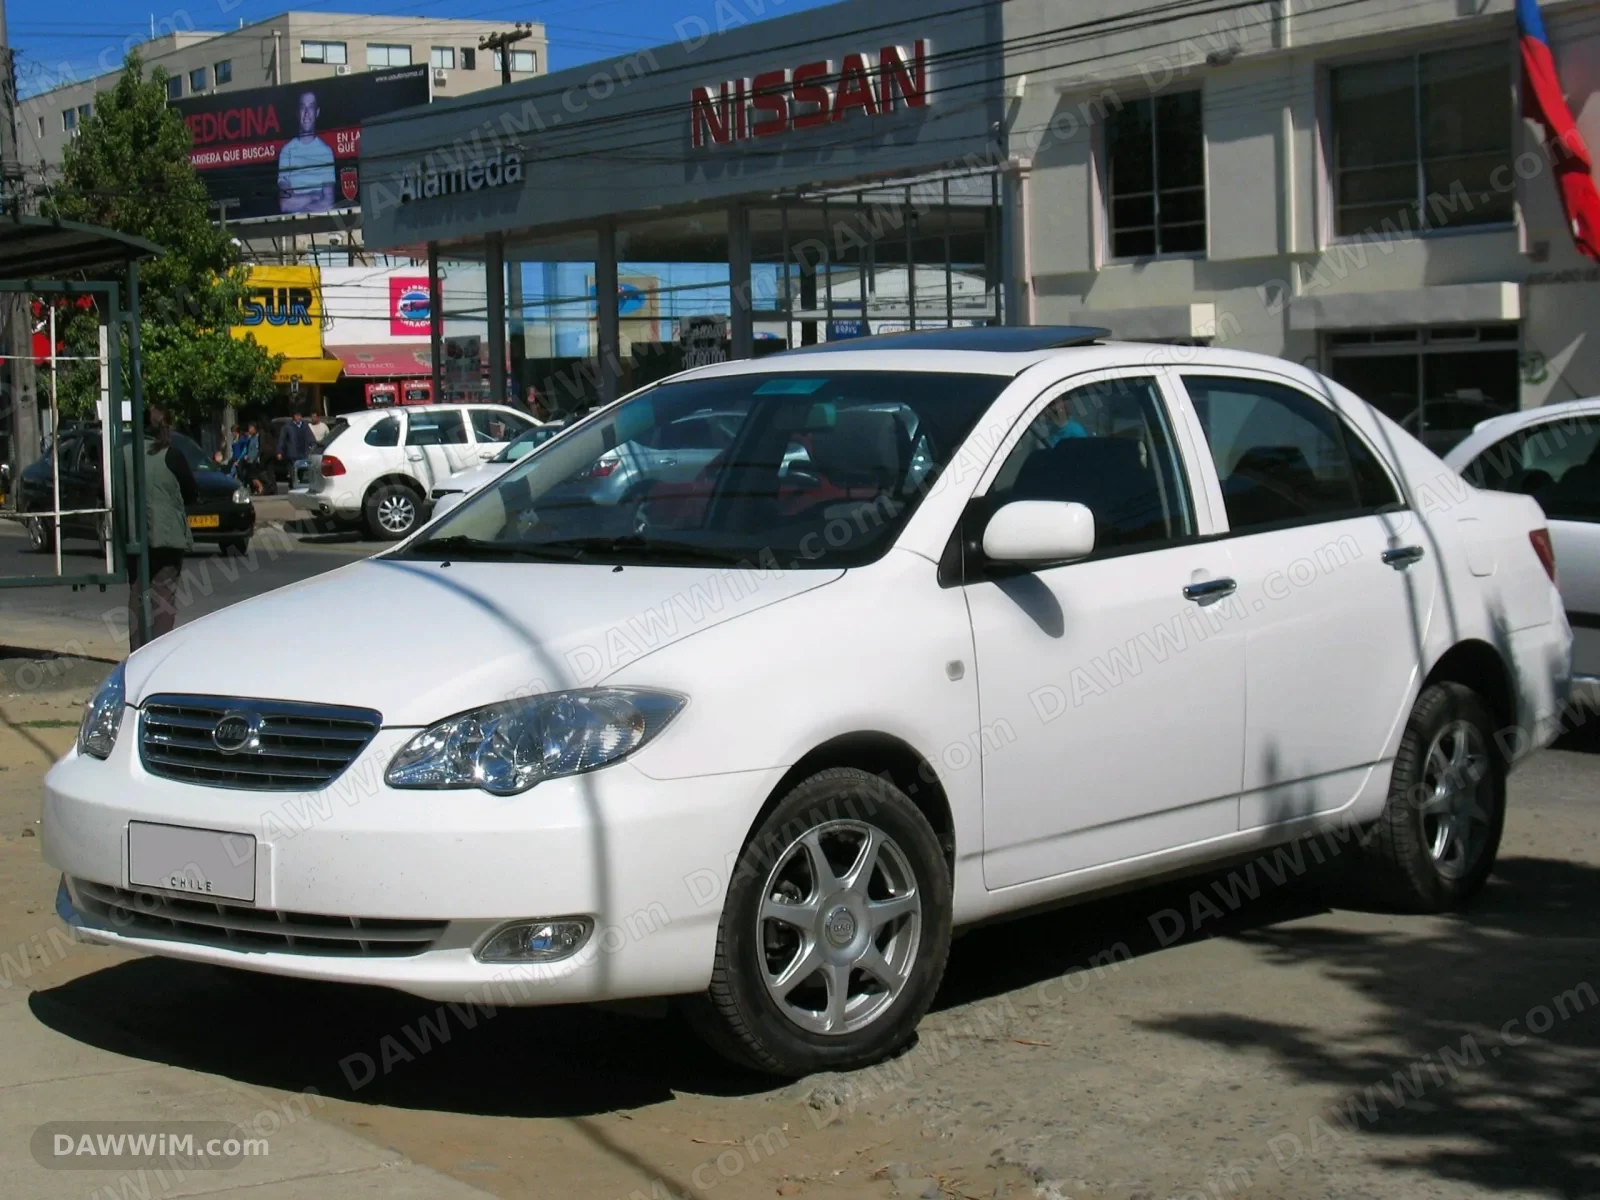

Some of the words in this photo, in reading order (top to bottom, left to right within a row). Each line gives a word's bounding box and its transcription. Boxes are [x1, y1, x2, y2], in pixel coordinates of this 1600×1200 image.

[691, 39, 931, 148] NISSAN
[185, 105, 281, 144] EDICINA
[337, 132, 349, 143] EN
[188, 152, 222, 164] ARRERA
[223, 149, 241, 162] QUE
[242, 145, 276, 160] BUSCAS
[337, 142, 356, 153] QUE
[399, 147, 523, 201] Alameda
[237, 288, 312, 326] SUR
[170, 876, 213, 892] CHILE
